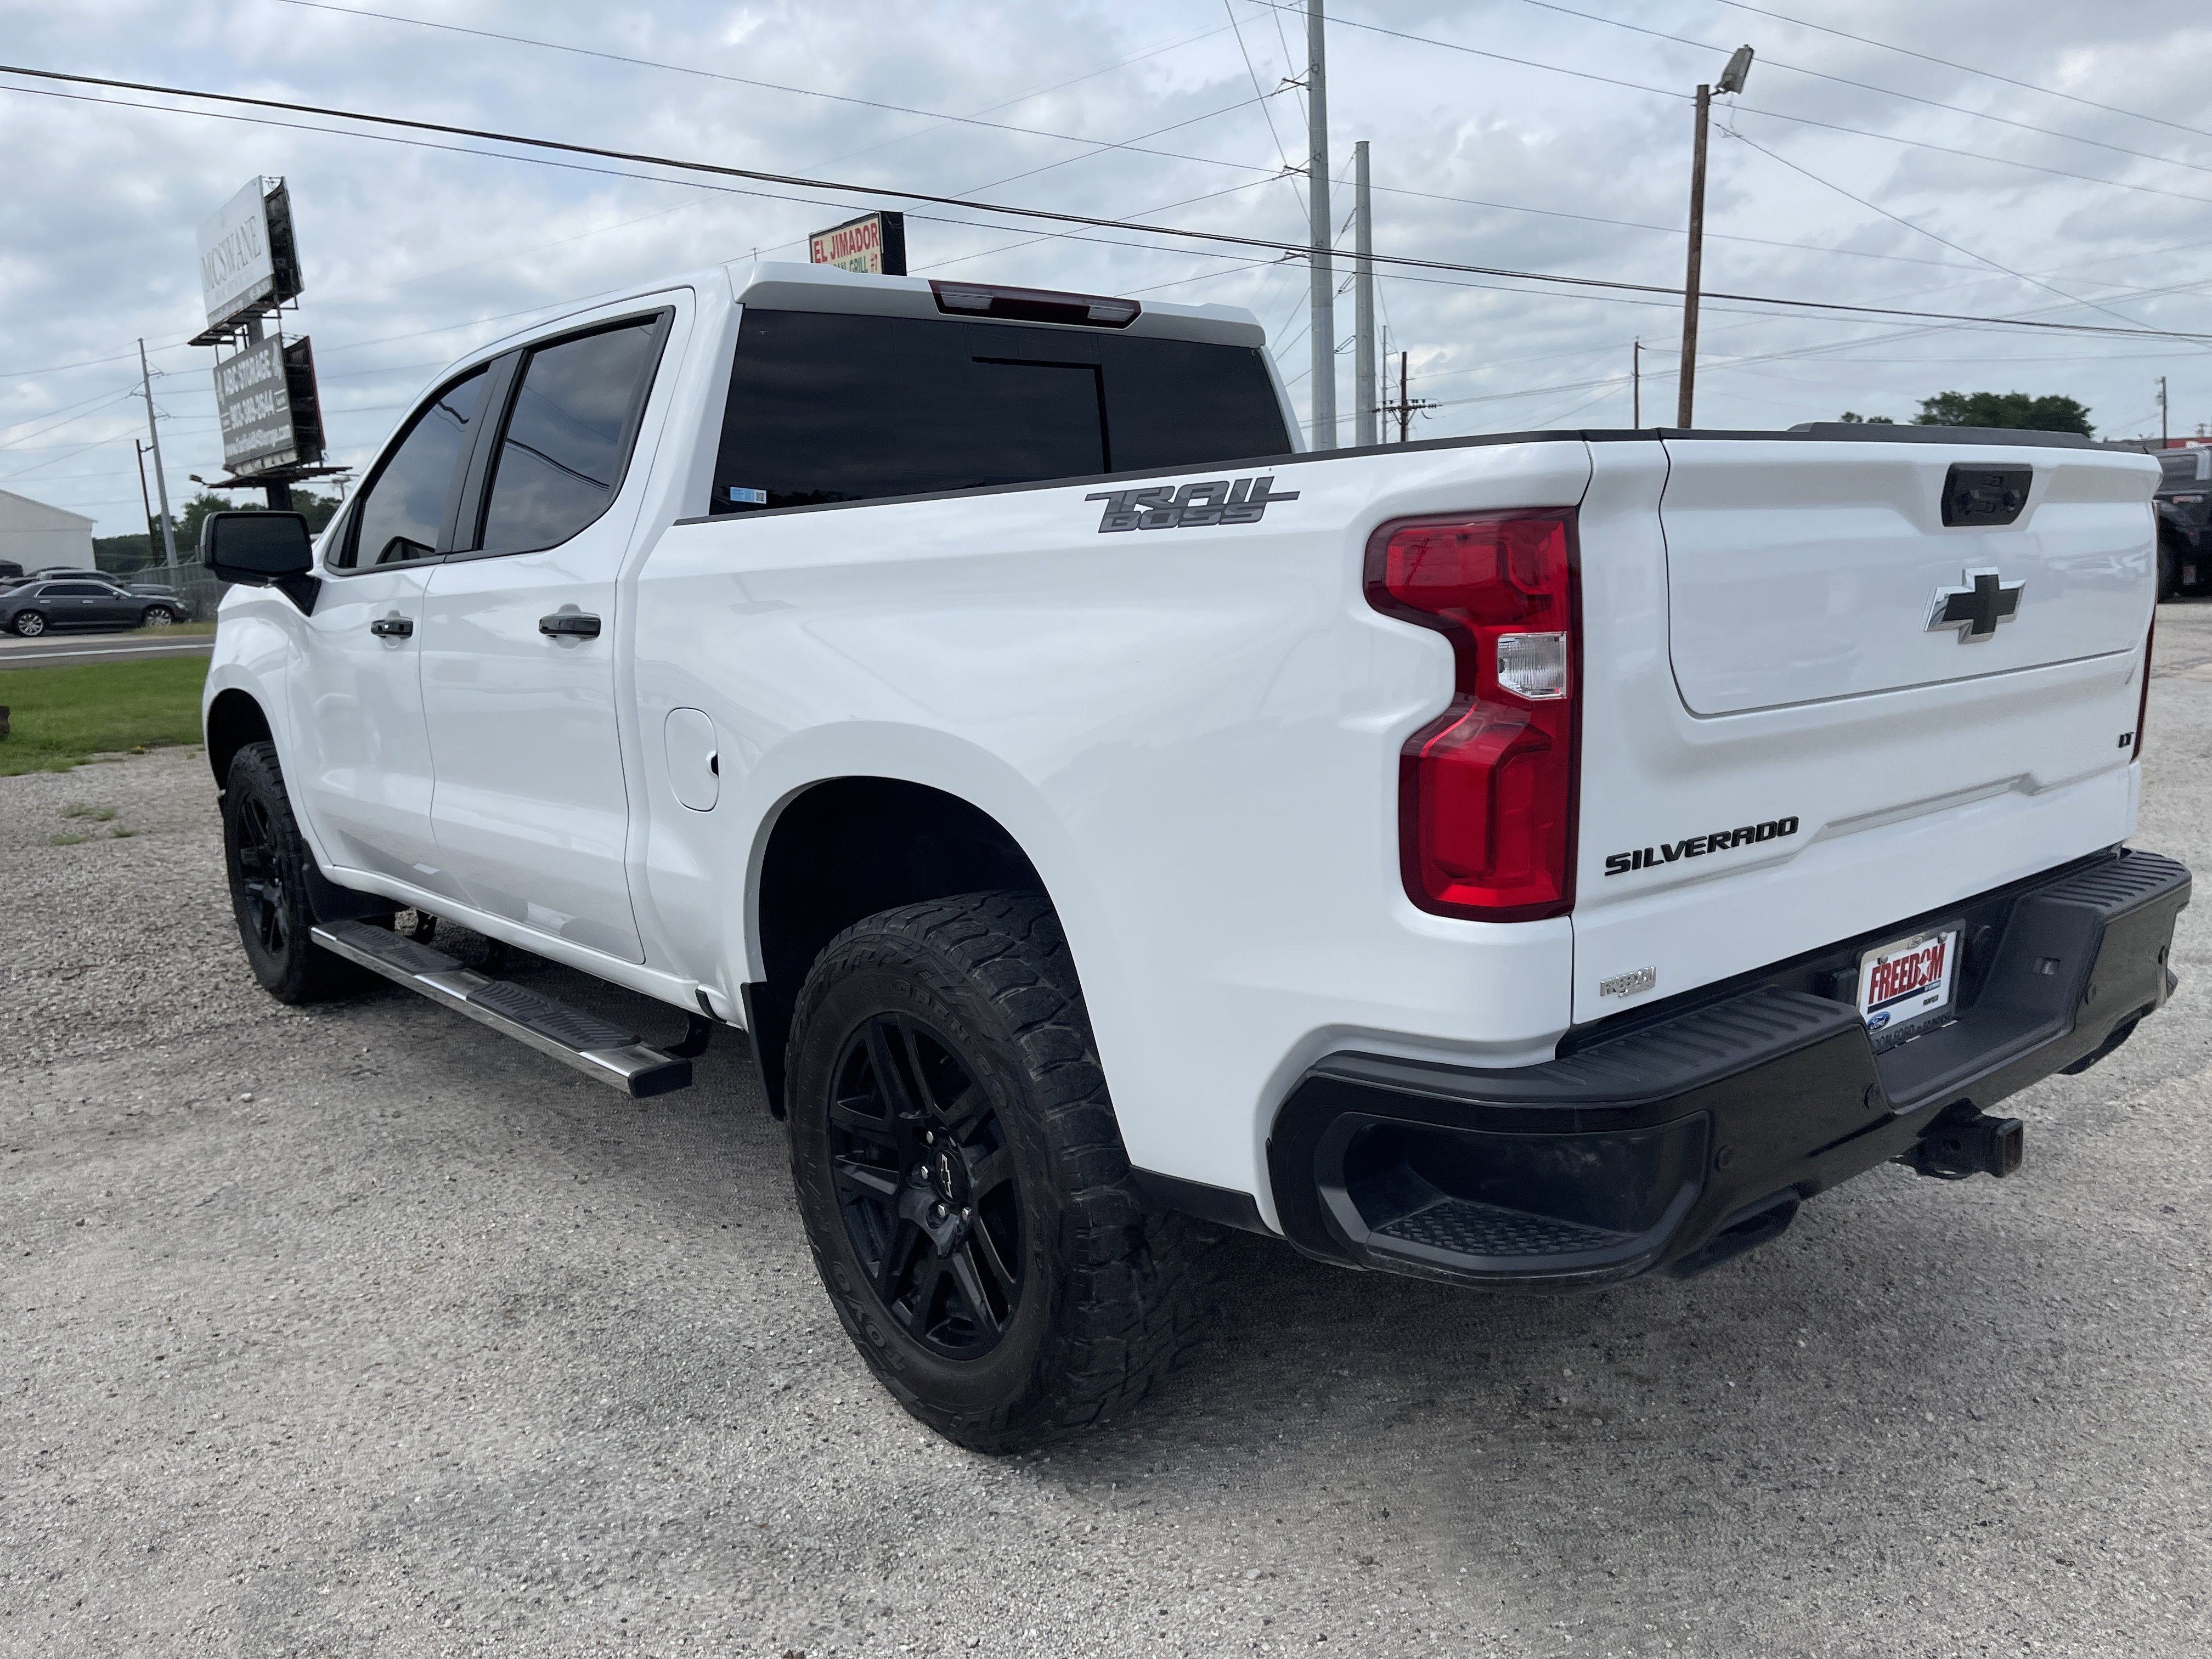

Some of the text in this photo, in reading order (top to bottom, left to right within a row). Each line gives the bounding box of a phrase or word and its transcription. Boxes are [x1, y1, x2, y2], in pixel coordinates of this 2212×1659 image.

[813, 222, 879, 263] EL JIMADOR
[1085, 476, 1301, 512] TRAIL
[1098, 501, 1267, 534] BOSS
[1604, 815, 1799, 876] SILVERADO
[1868, 943, 1946, 1005] FREEDOM
